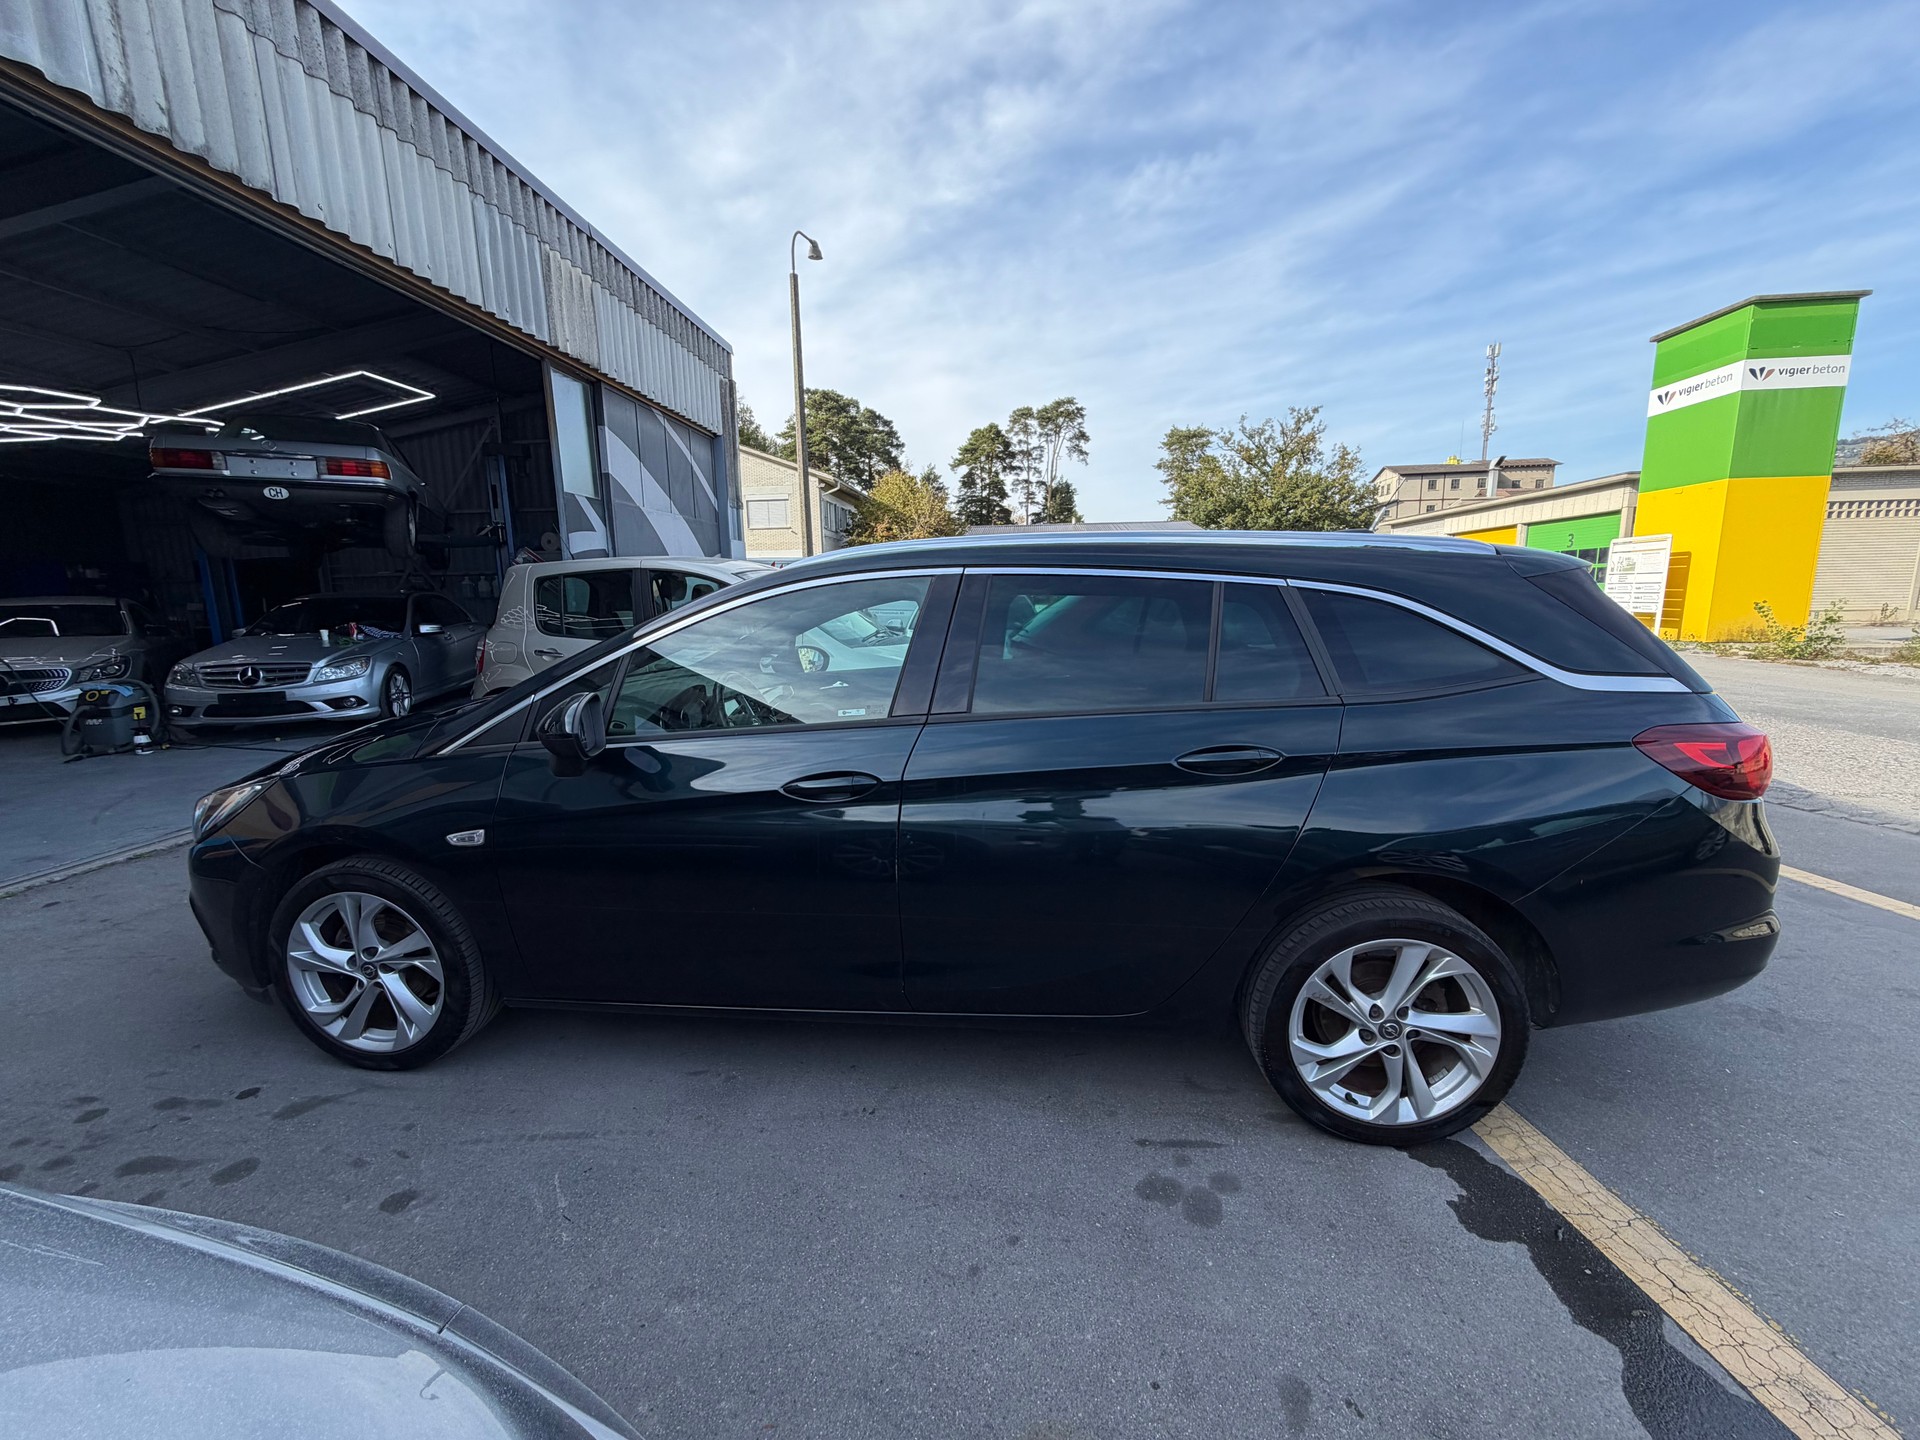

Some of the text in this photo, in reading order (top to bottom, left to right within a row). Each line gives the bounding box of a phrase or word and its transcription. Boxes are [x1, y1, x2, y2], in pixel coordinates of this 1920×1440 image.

[1778, 364, 1845, 377] vigier beton
[1678, 373, 1733, 396] vigier beton
[268, 487, 283, 498] CH
[1566, 533, 1574, 548] 3
